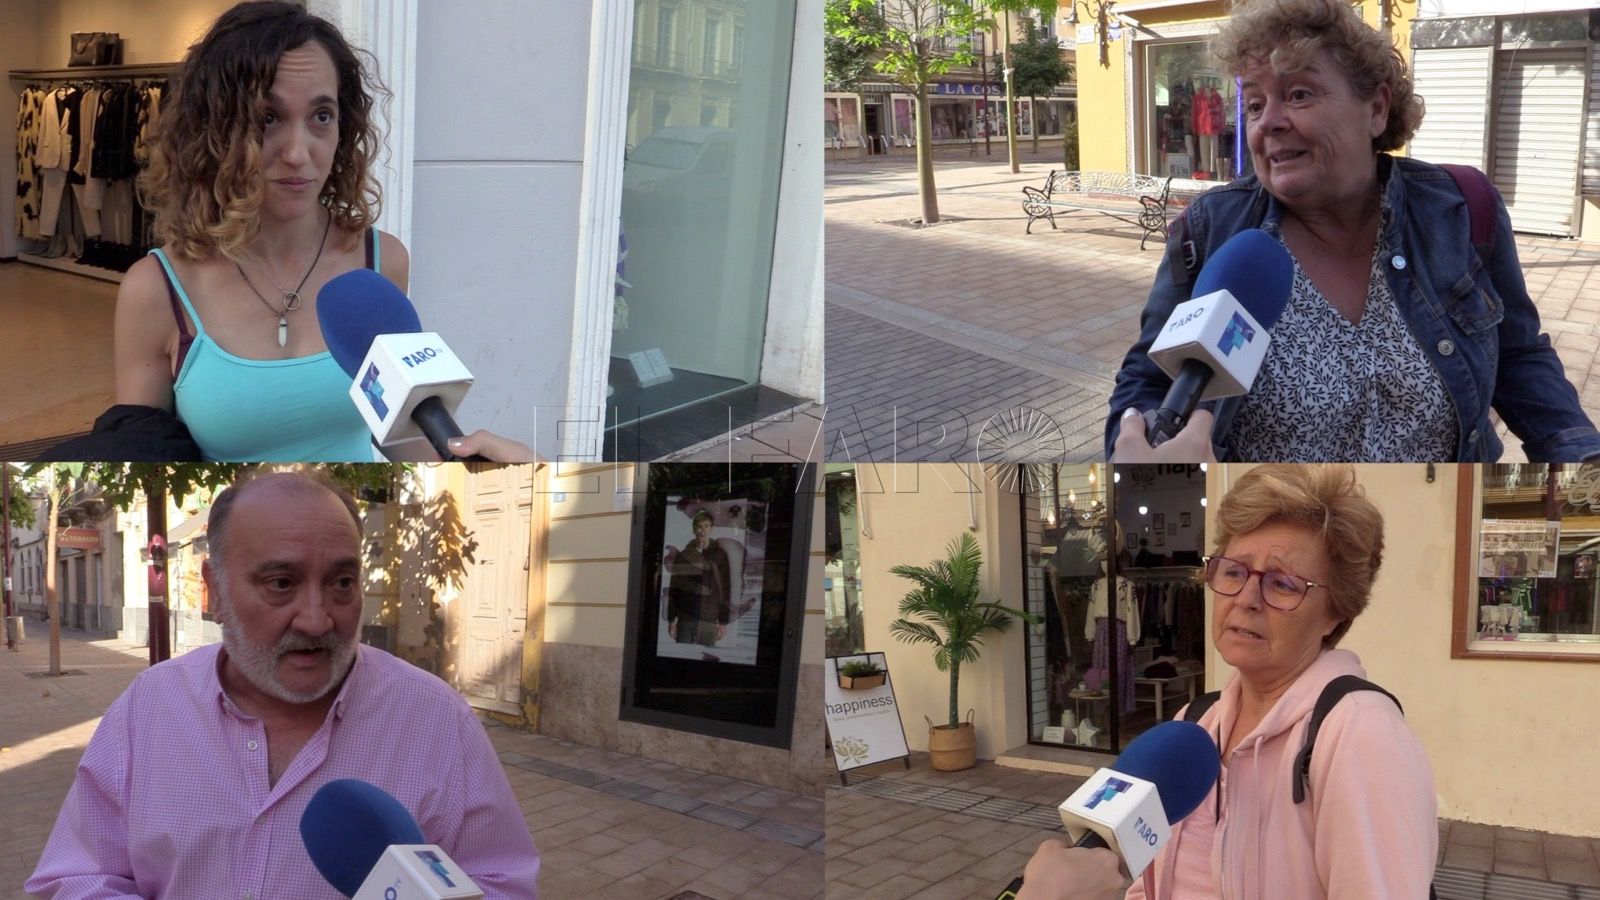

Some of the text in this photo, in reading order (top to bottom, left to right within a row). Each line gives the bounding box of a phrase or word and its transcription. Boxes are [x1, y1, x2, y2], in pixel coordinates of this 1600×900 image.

[945, 83, 966, 95] LA
[1168, 307, 1205, 332] FARO
[401, 347, 437, 368] FARO
[826, 695, 894, 716] happiness
[1133, 816, 1159, 847] FARO
